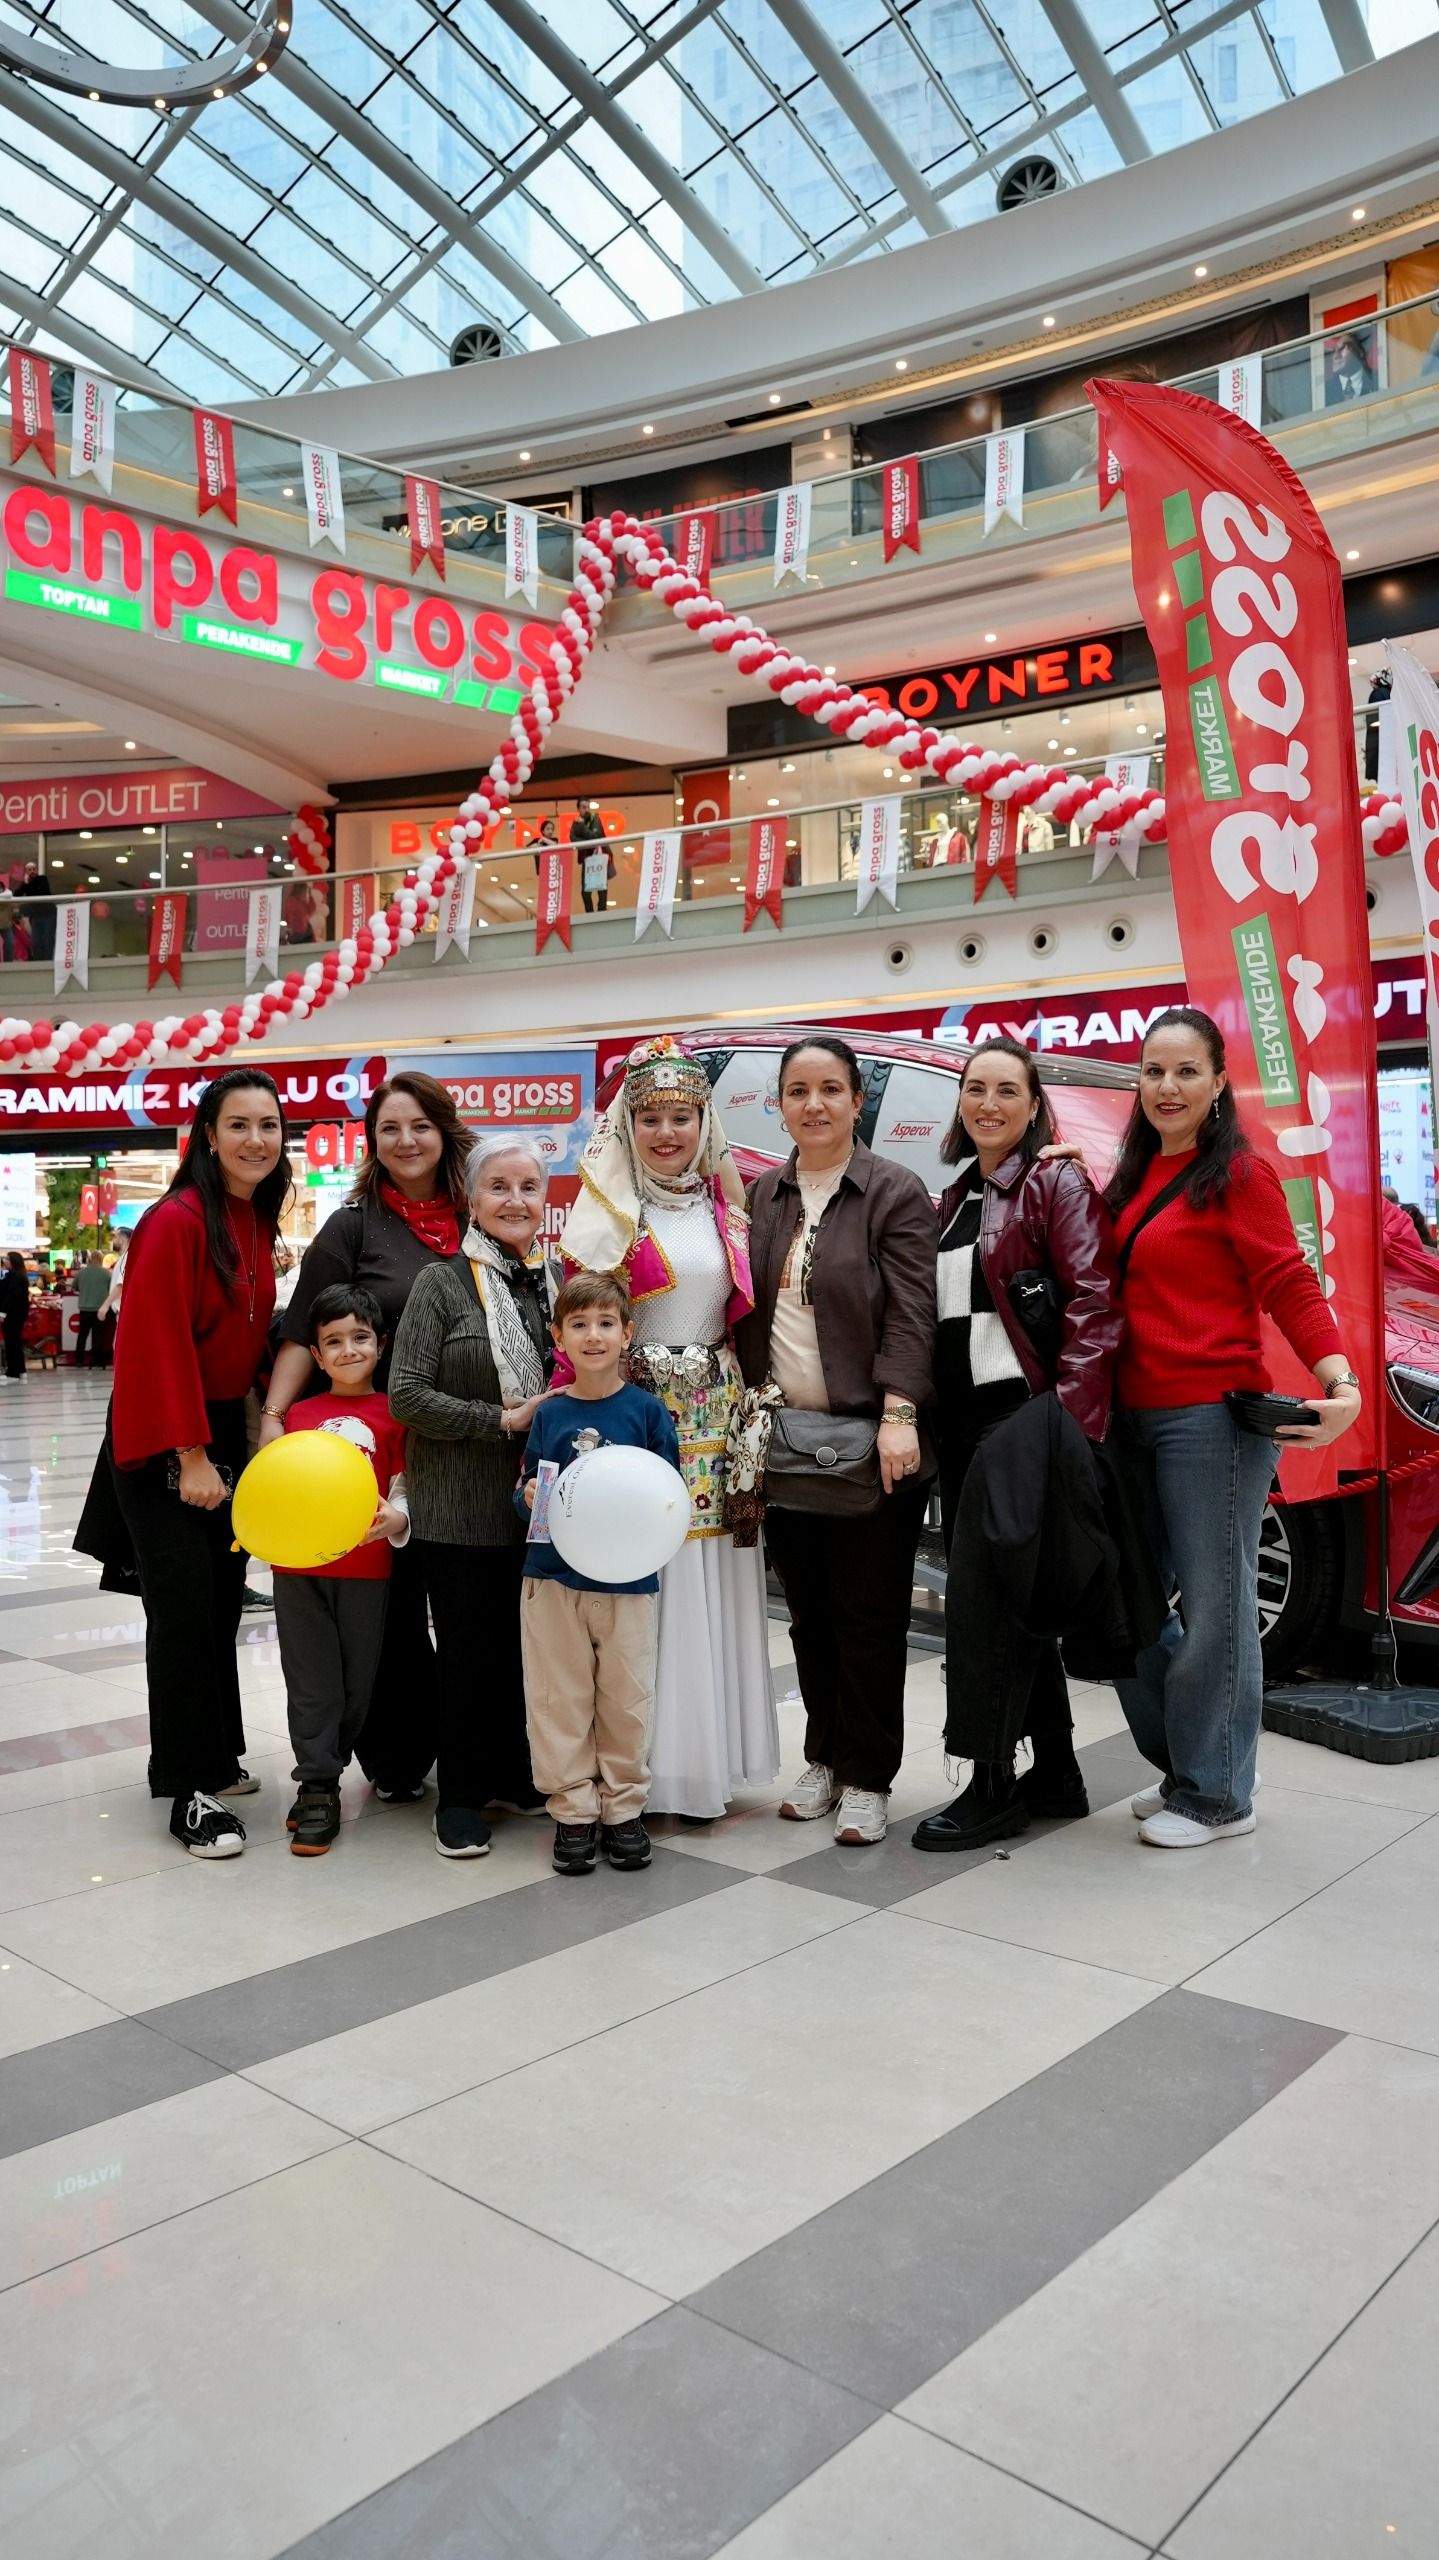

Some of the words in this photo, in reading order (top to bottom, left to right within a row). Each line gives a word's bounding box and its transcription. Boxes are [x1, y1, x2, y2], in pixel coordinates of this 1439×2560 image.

[20, 359, 34, 399] gross
[1231, 368, 1243, 403] gross
[22, 399, 35, 435] anpa
[83, 382, 97, 421] gross
[83, 421, 97, 461] anpa
[202, 418, 217, 456] gross
[312, 453, 325, 489] gross
[997, 441, 1008, 473] gross
[203, 458, 219, 496] anpa
[890, 467, 904, 503] gross
[996, 475, 1006, 506] anpa
[315, 493, 328, 527] anpa
[415, 483, 430, 515] gross
[784, 495, 796, 528] gross
[418, 517, 431, 548] anpa
[513, 515, 524, 548] gross
[689, 519, 700, 553] gross
[892, 504, 904, 539] anpa
[4, 485, 279, 630] anpa
[782, 533, 794, 563] anpa
[514, 550, 526, 582] anpa
[687, 554, 698, 576] npa
[40, 585, 110, 616] TOPTAN
[196, 622, 293, 659] PERAKENDE
[79, 781, 207, 819] OUTLET
[990, 801, 1003, 826] gro
[870, 807, 882, 842] gross
[651, 840, 662, 874] gross
[757, 825, 770, 861] gross
[987, 830, 999, 866] anpa
[546, 855, 558, 889] gross
[755, 863, 766, 899] anpa
[869, 848, 881, 882] anpa
[256, 896, 267, 924] gross
[352, 884, 362, 917] gross
[546, 892, 556, 924] anpa
[648, 878, 658, 910] anpa
[66, 908, 75, 938] gross
[160, 900, 172, 930] gross
[206, 924, 249, 938] OUTLE
[446, 903, 458, 933] anpa
[65, 940, 74, 969] anpa
[157, 932, 169, 963] anpa
[256, 928, 265, 957] anpa
[492, 1082, 574, 1118] gross
[729, 1094, 757, 1105] Asperox
[763, 1096, 780, 1108] Pero
[890, 1123, 933, 1139] Asperox
